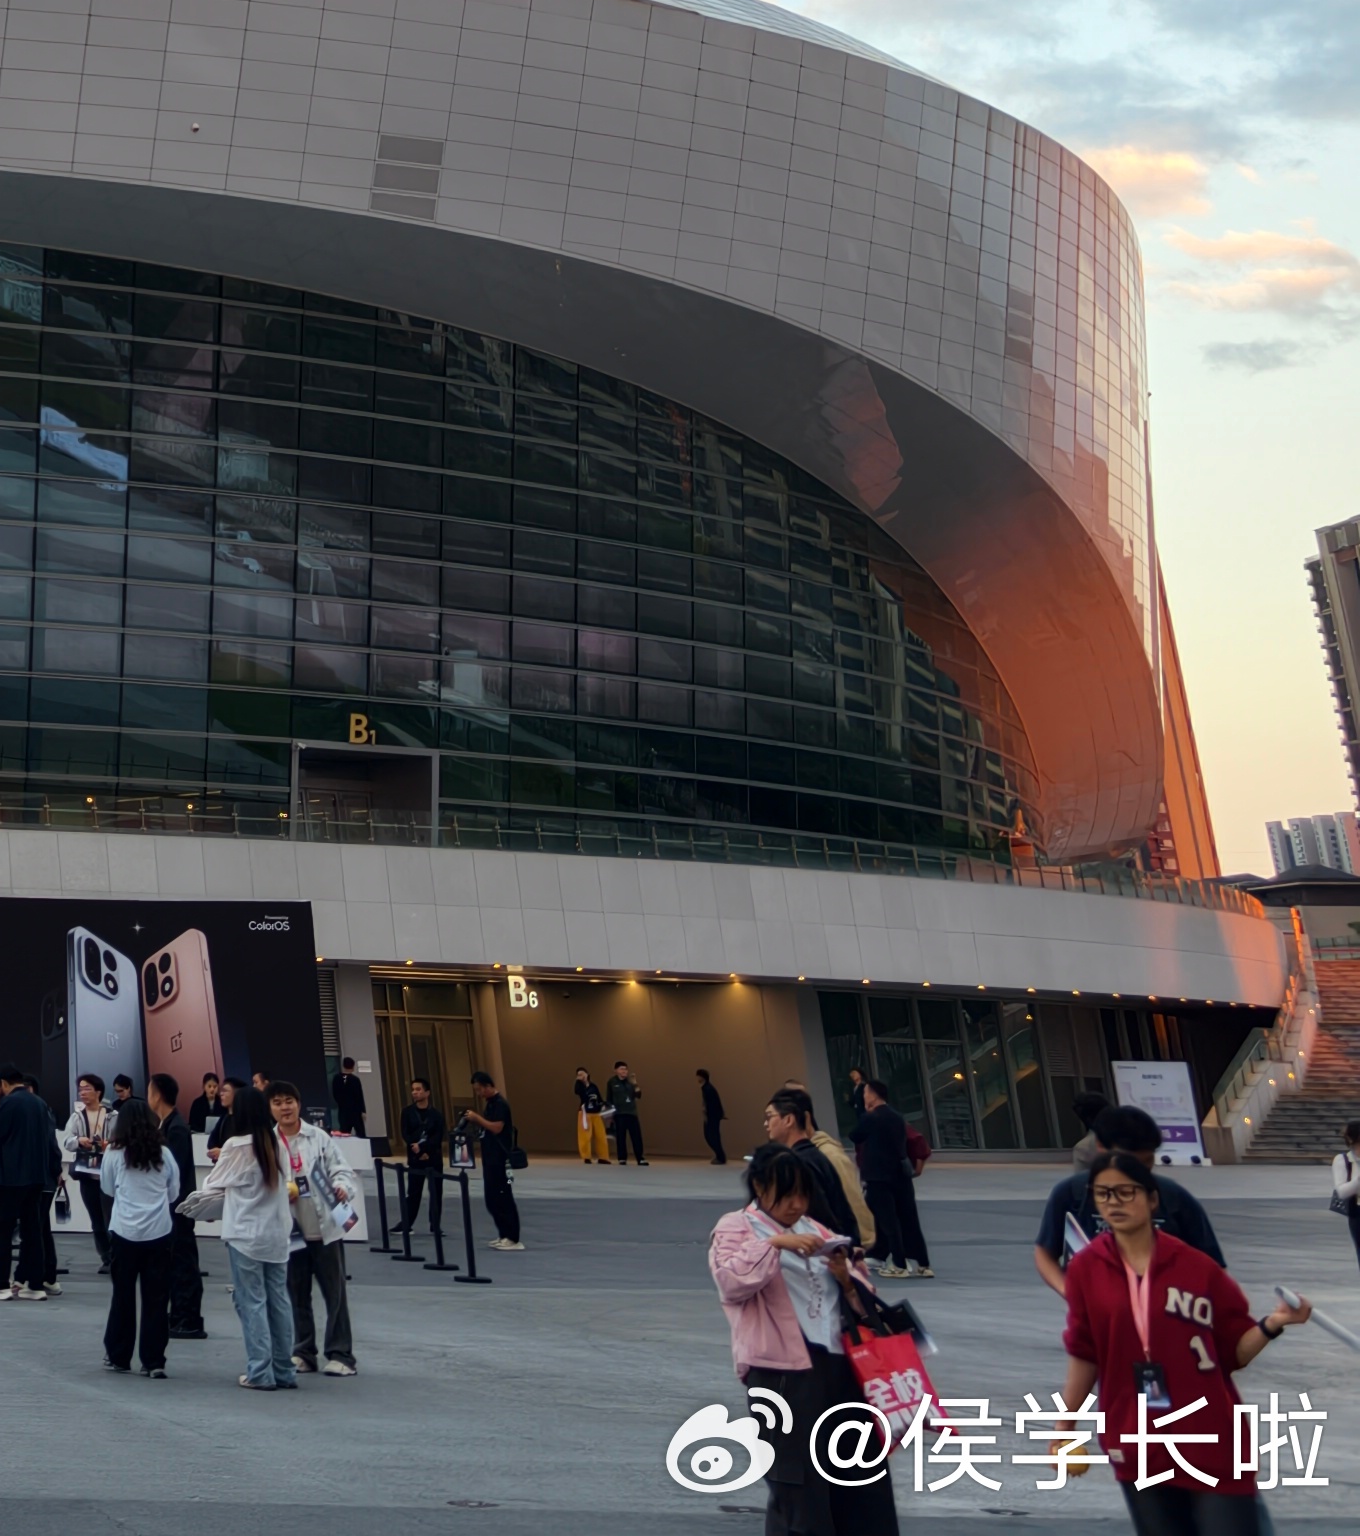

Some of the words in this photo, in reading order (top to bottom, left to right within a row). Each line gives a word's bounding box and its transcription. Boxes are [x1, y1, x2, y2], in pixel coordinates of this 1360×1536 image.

[349, 712, 376, 746] B1
[248, 920, 291, 931] ColorOS
[507, 975, 539, 1009] B6
[1189, 1335, 1216, 1371] 1
